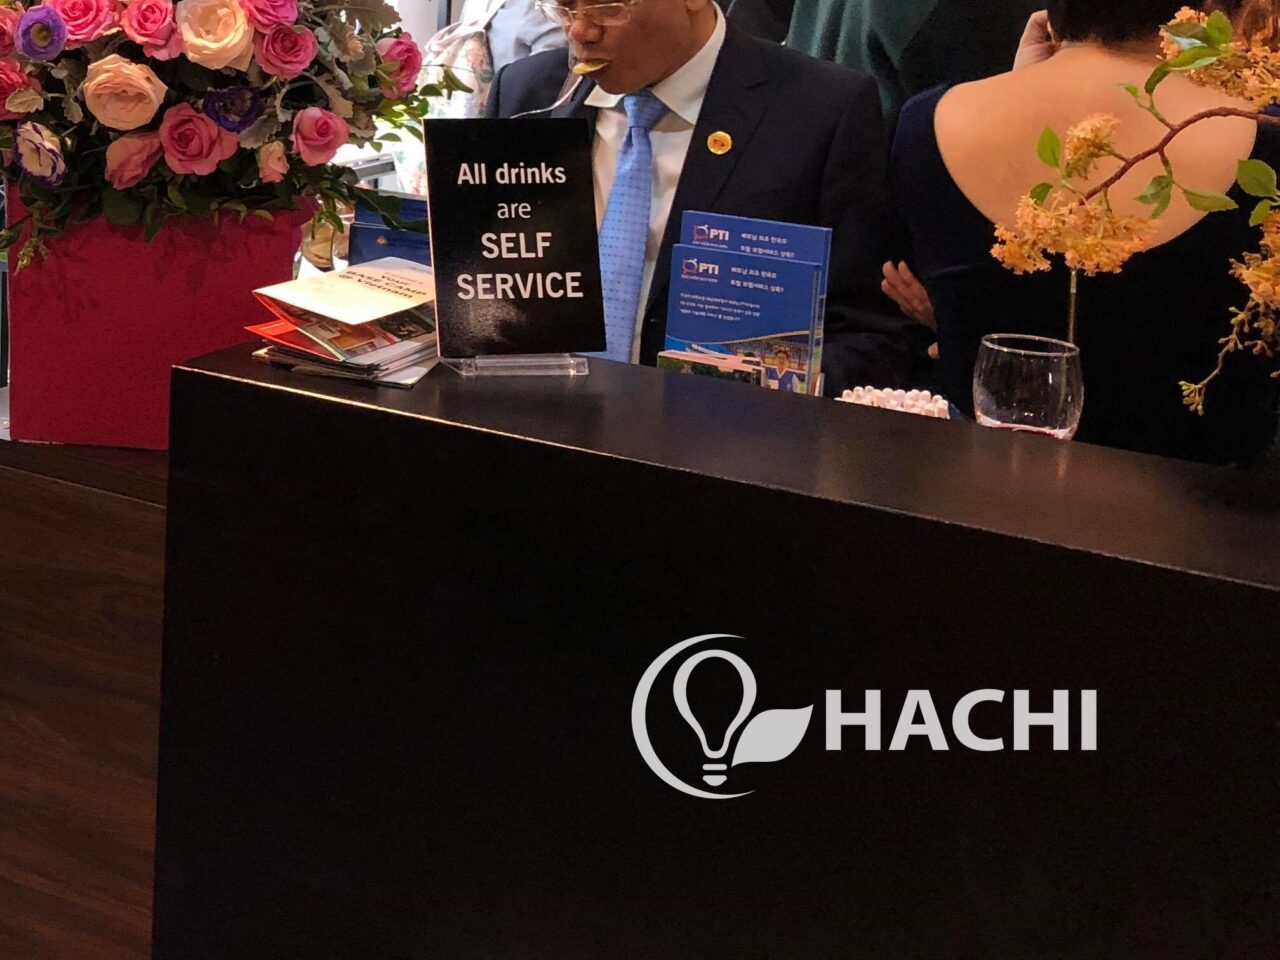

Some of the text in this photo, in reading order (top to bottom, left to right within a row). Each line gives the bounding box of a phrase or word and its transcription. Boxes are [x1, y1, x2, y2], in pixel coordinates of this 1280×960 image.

[457, 162, 567, 185] All drinks
[497, 202, 531, 219] are
[709, 228, 729, 241] PTI
[481, 232, 552, 259] SELF
[699, 262, 719, 275] PTI
[357, 278, 414, 299] Vietnam
[384, 281, 427, 296] CAMP
[456, 272, 584, 300] SERVICE
[825, 688, 1097, 751] HACHI
